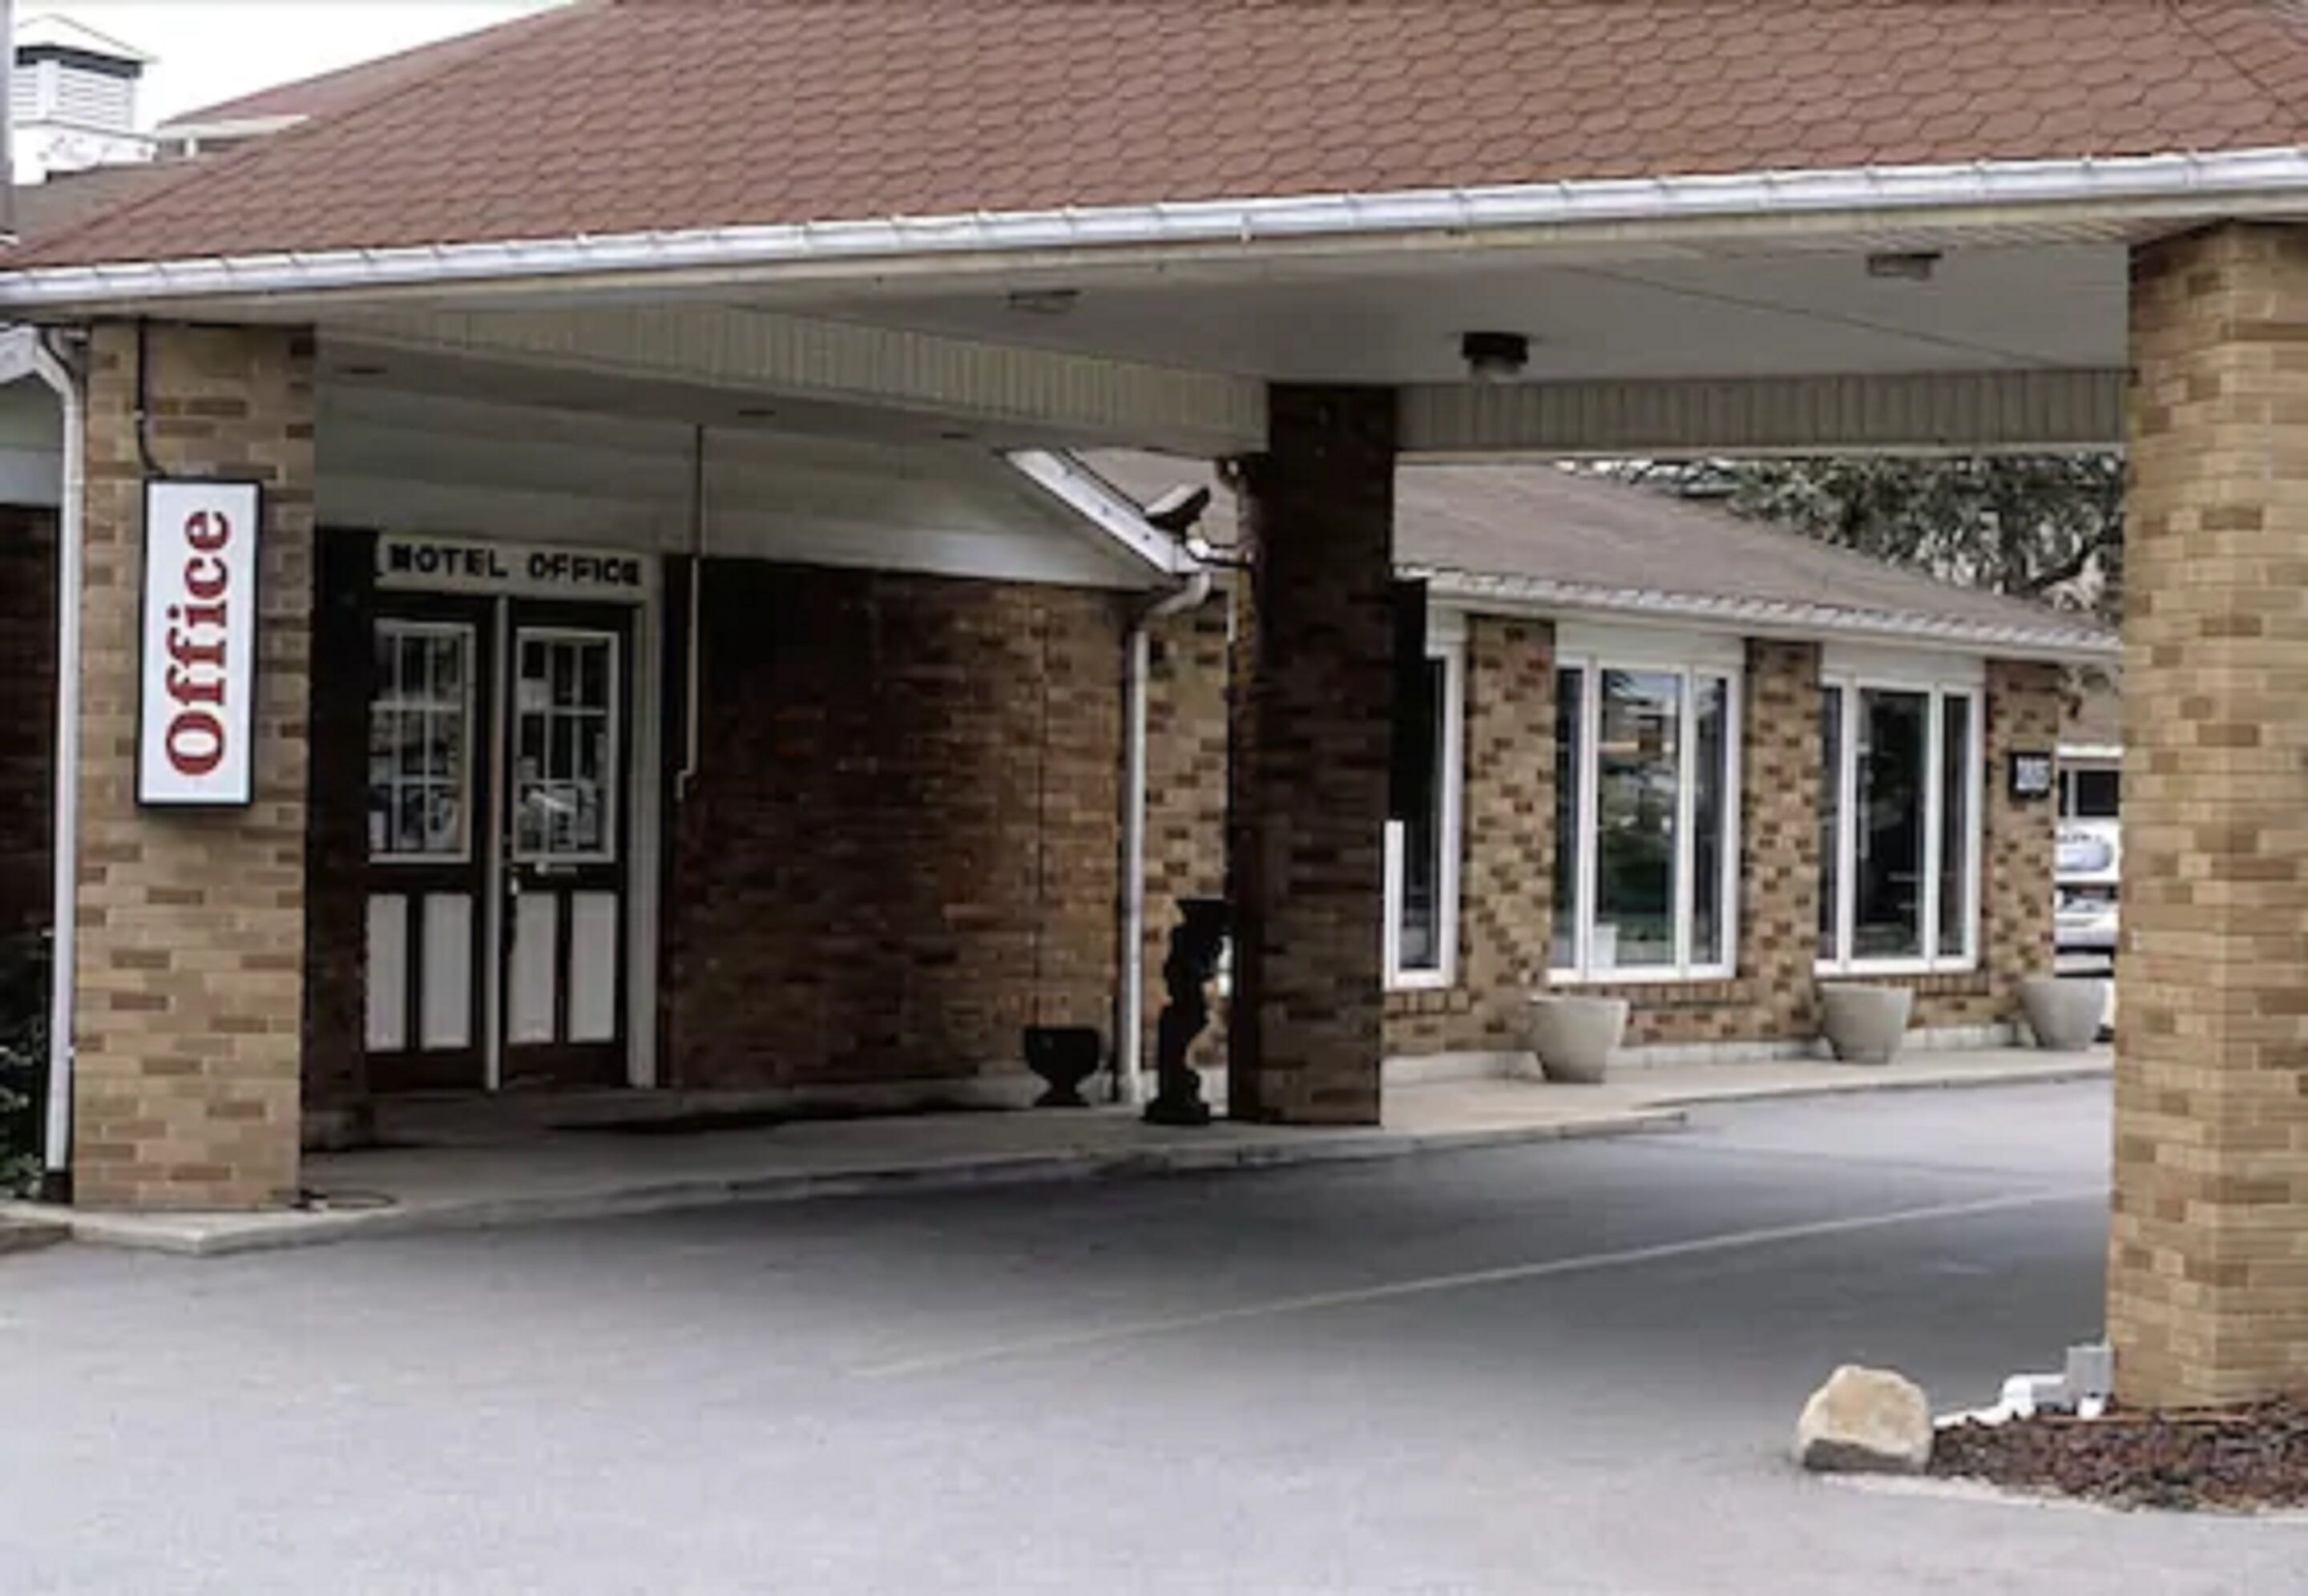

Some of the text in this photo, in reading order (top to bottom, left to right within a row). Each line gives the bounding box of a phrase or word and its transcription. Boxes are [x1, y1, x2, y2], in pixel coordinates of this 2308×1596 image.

[388, 543, 640, 586] MOTEL OFFICE
[165, 510, 230, 776] Office
